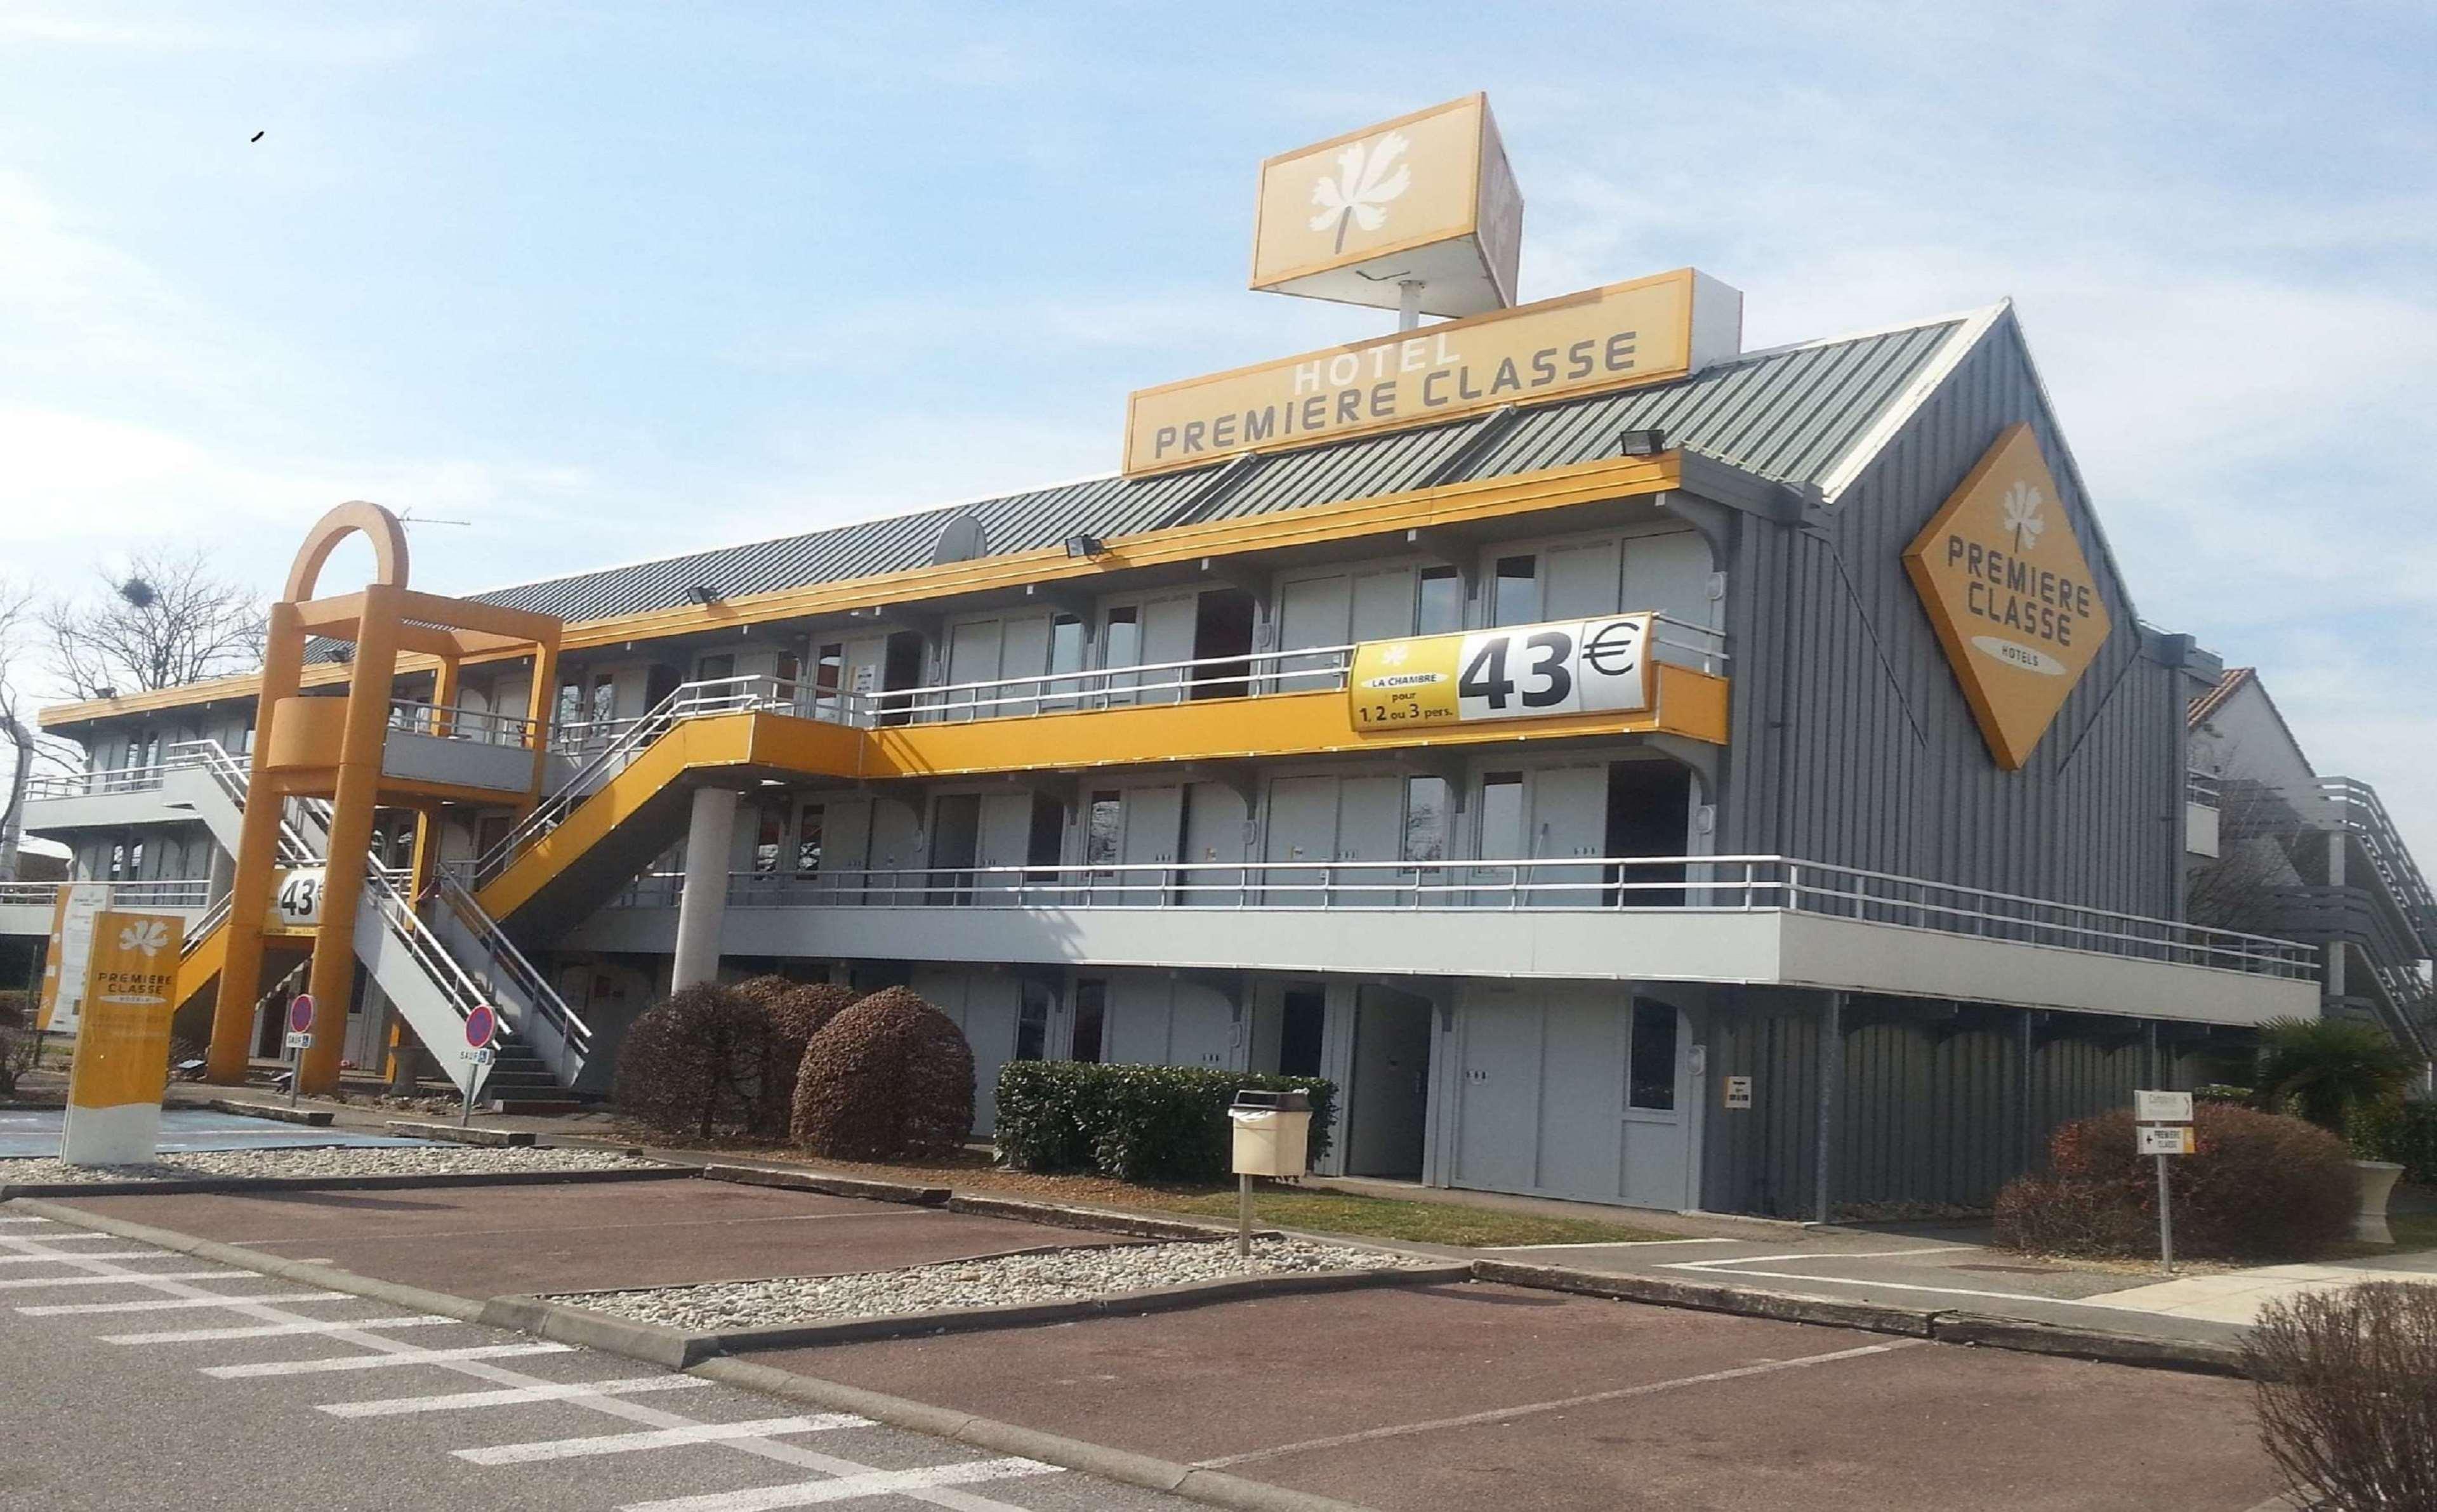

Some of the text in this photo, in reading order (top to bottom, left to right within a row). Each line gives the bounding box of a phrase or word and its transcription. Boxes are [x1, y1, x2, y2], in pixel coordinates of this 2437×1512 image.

[1295, 332, 1461, 393] HOTEL
[1155, 331, 1638, 459] PREMIERE CLASSE
[1948, 535, 2090, 618] PREMIERE
[1968, 581, 2071, 647] CLASSE
[2002, 645, 2038, 667] HOTELS
[1388, 674, 1437, 686] CHAMBRE
[1392, 692, 1417, 702] pour
[1376, 706, 1387, 721] 2
[1410, 704, 1420, 718] 3
[1424, 707, 1453, 719] pers.
[98, 973, 172, 985] PREMIERE
[107, 983, 163, 994] CLASSE
